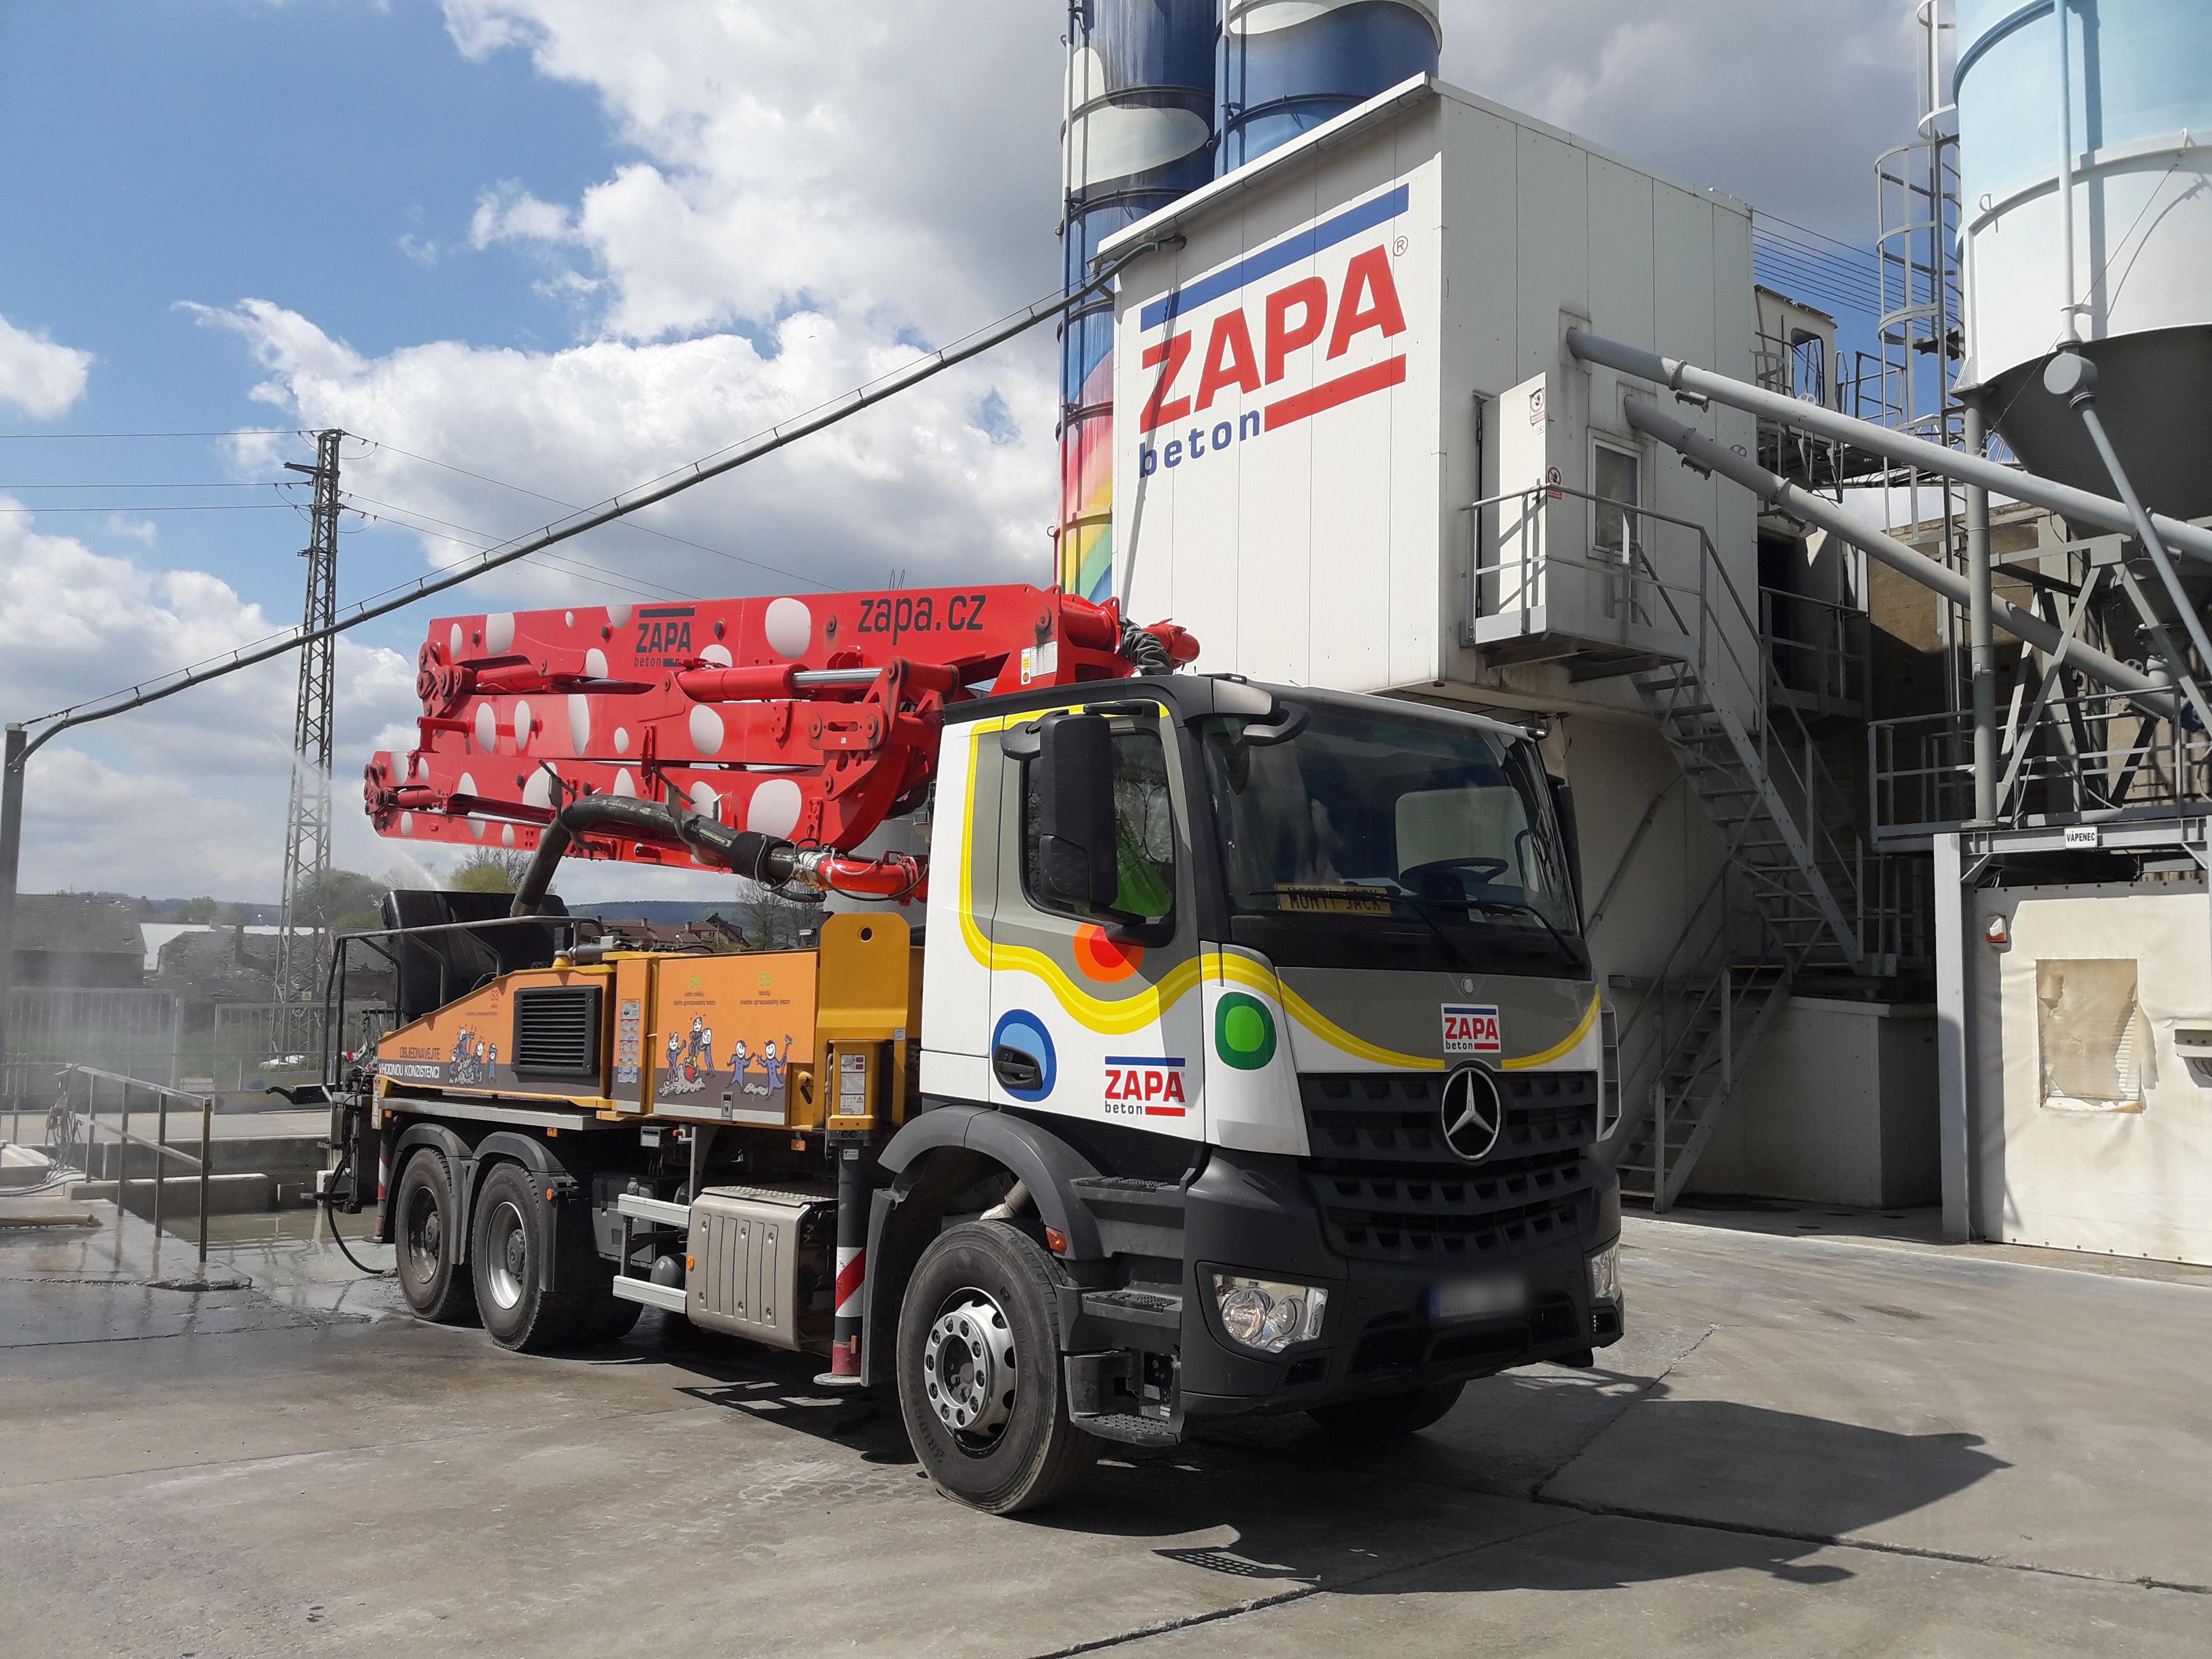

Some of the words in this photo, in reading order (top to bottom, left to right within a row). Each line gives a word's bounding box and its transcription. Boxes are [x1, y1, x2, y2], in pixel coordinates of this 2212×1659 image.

[1140, 244, 1407, 434] ZAPA
[1140, 410, 1260, 479] beton
[857, 594, 987, 646] zapa.cz
[636, 622, 691, 653] ZAPA
[634, 655, 661, 667] beton
[2067, 830, 2095, 842] VÁPENEC
[1445, 1017, 1499, 1040] ZAPA
[1446, 1040, 1473, 1050] beton
[379, 1063, 404, 1076] VHODNOU
[404, 1065, 440, 1078] KONZISTENCI
[1105, 1070, 1186, 1103] ZAPA
[1105, 1100, 1142, 1115] beton
